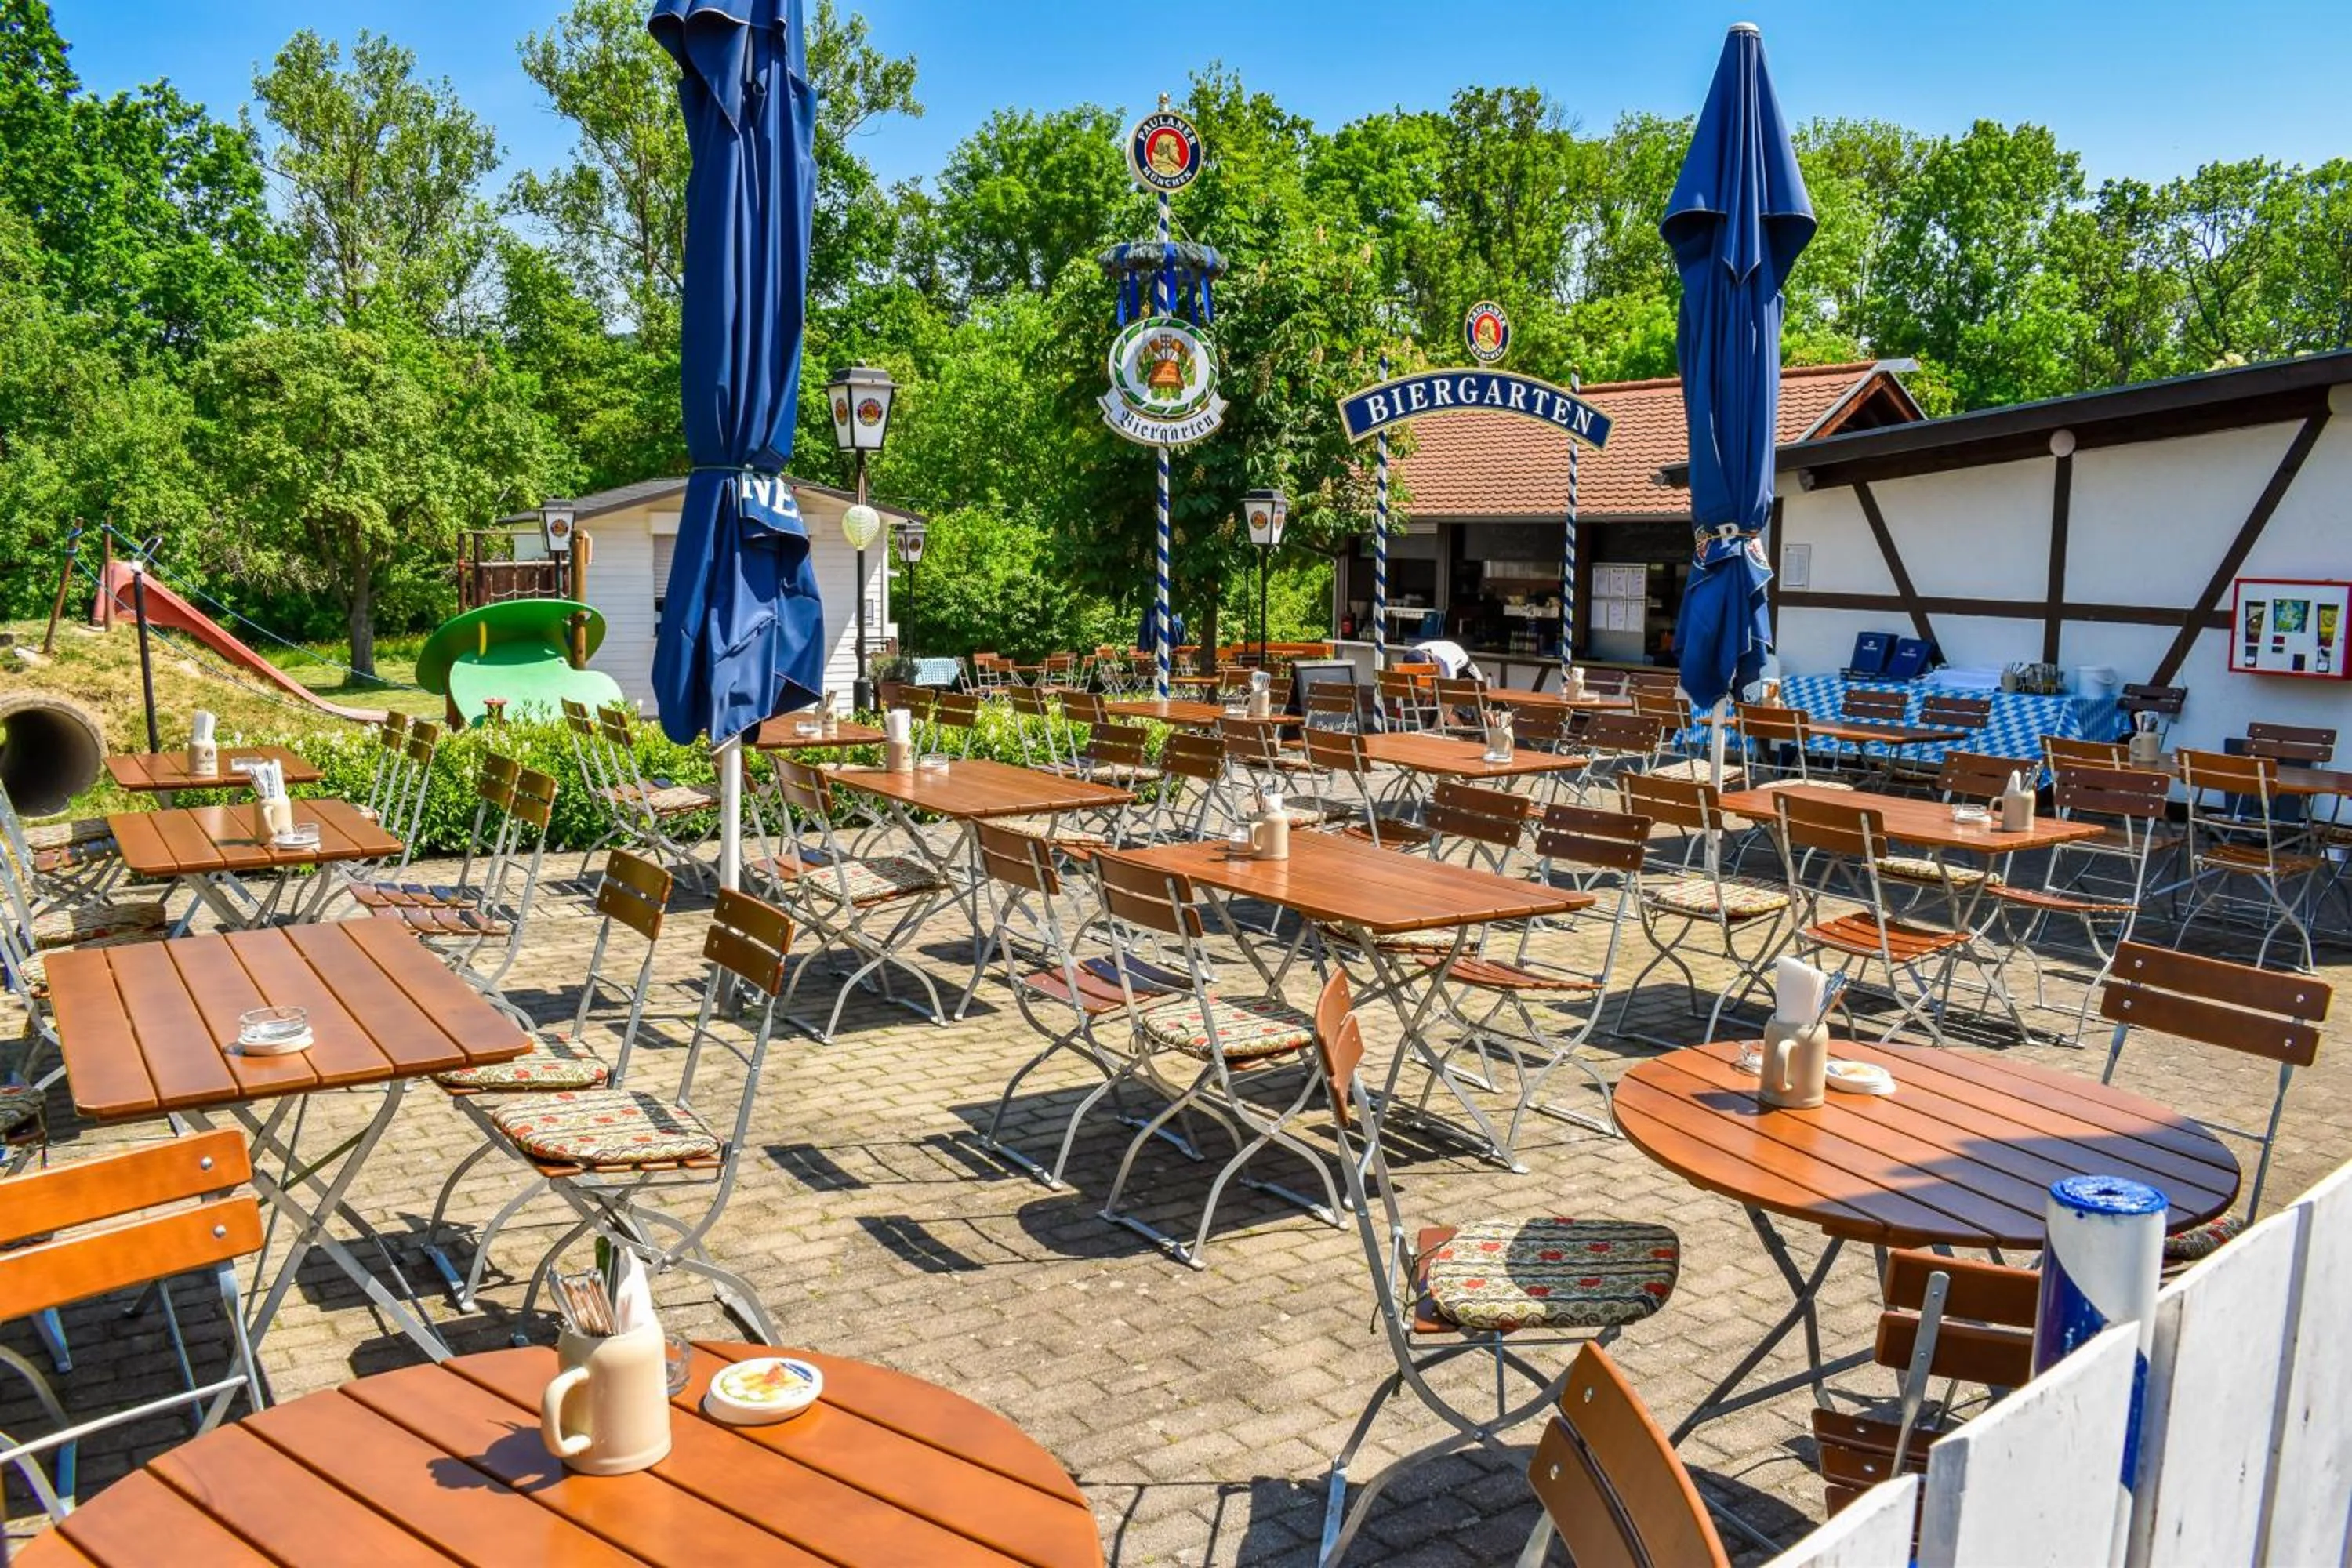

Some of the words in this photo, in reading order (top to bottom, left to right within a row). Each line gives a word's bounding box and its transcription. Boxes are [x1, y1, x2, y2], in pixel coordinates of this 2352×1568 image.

[1138, 116, 1197, 146] PAULANER
[1365, 376, 1595, 436] BIERGARTEN
[1120, 411, 1215, 443] Biergarten
[742, 473, 803, 521] NE
